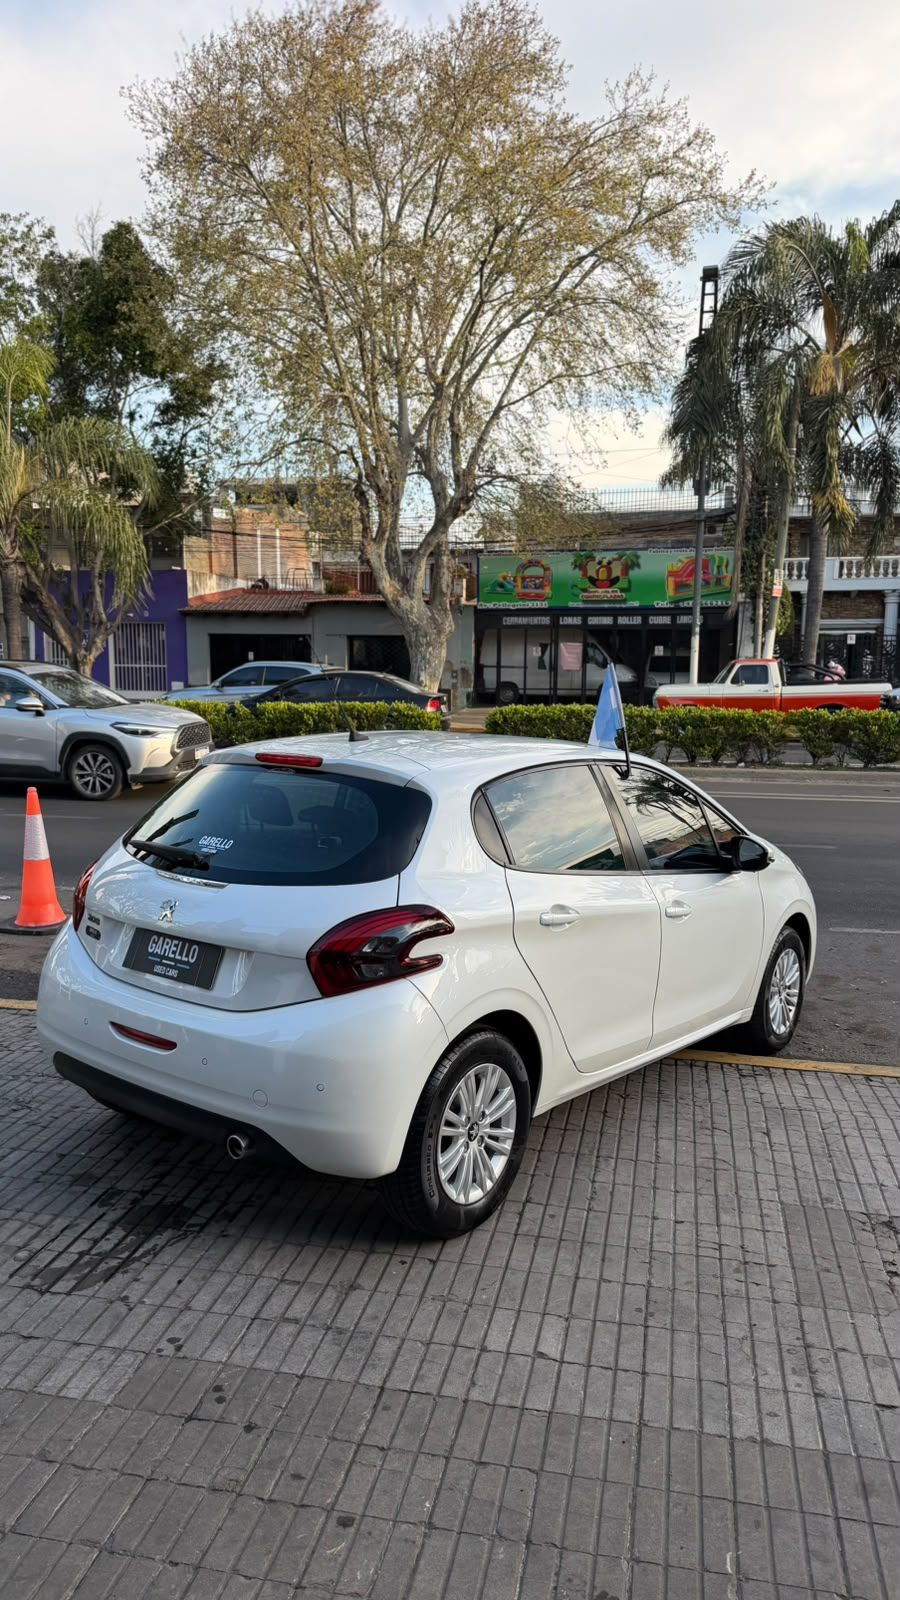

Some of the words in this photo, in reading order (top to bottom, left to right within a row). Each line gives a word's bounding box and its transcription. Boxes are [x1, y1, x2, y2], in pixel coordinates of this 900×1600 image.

[502, 616, 551, 625] CERRAMIENTOS
[559, 616, 582, 625] LONAS
[617, 616, 642, 625] ROLLER
[648, 616, 672, 625] CUBRE
[199, 835, 234, 849] GARELLO
[147, 935, 199, 963] GARELLO
[153, 964, 166, 975] USED
[165, 968, 179, 978] CARS
